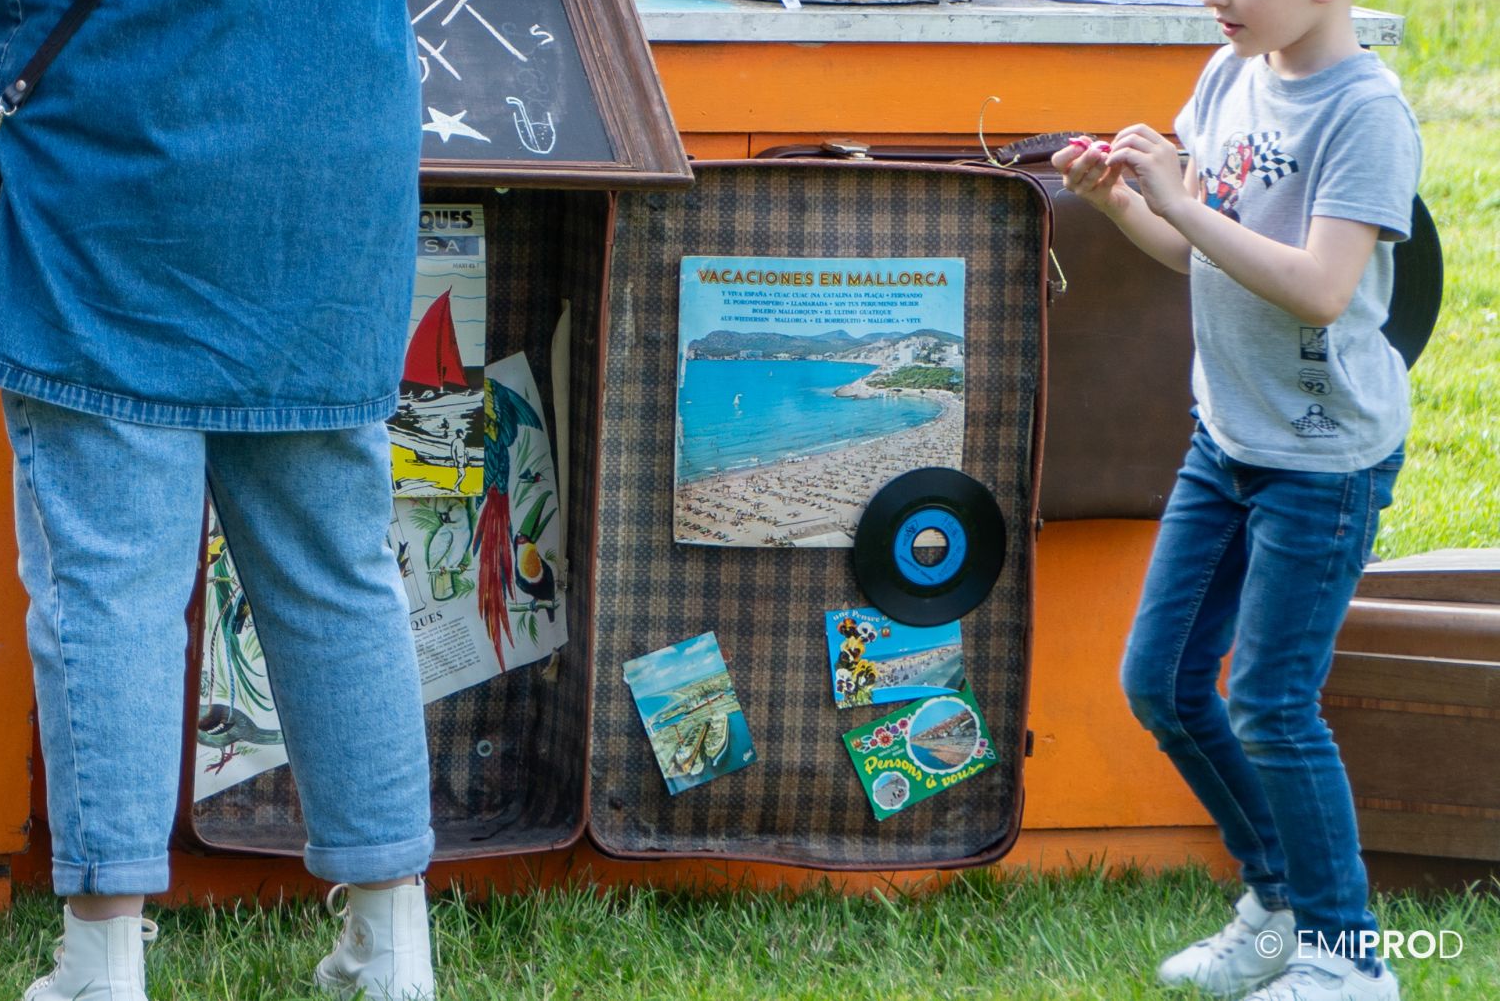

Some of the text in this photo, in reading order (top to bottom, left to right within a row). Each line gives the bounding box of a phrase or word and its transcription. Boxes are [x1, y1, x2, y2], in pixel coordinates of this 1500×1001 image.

[419, 209, 474, 231] QUES
[698, 269, 949, 287] VACACIONES EN MALLORCA
[410, 610, 444, 631] QUES
[864, 755, 923, 783] Pensons
[941, 763, 986, 788] vous
